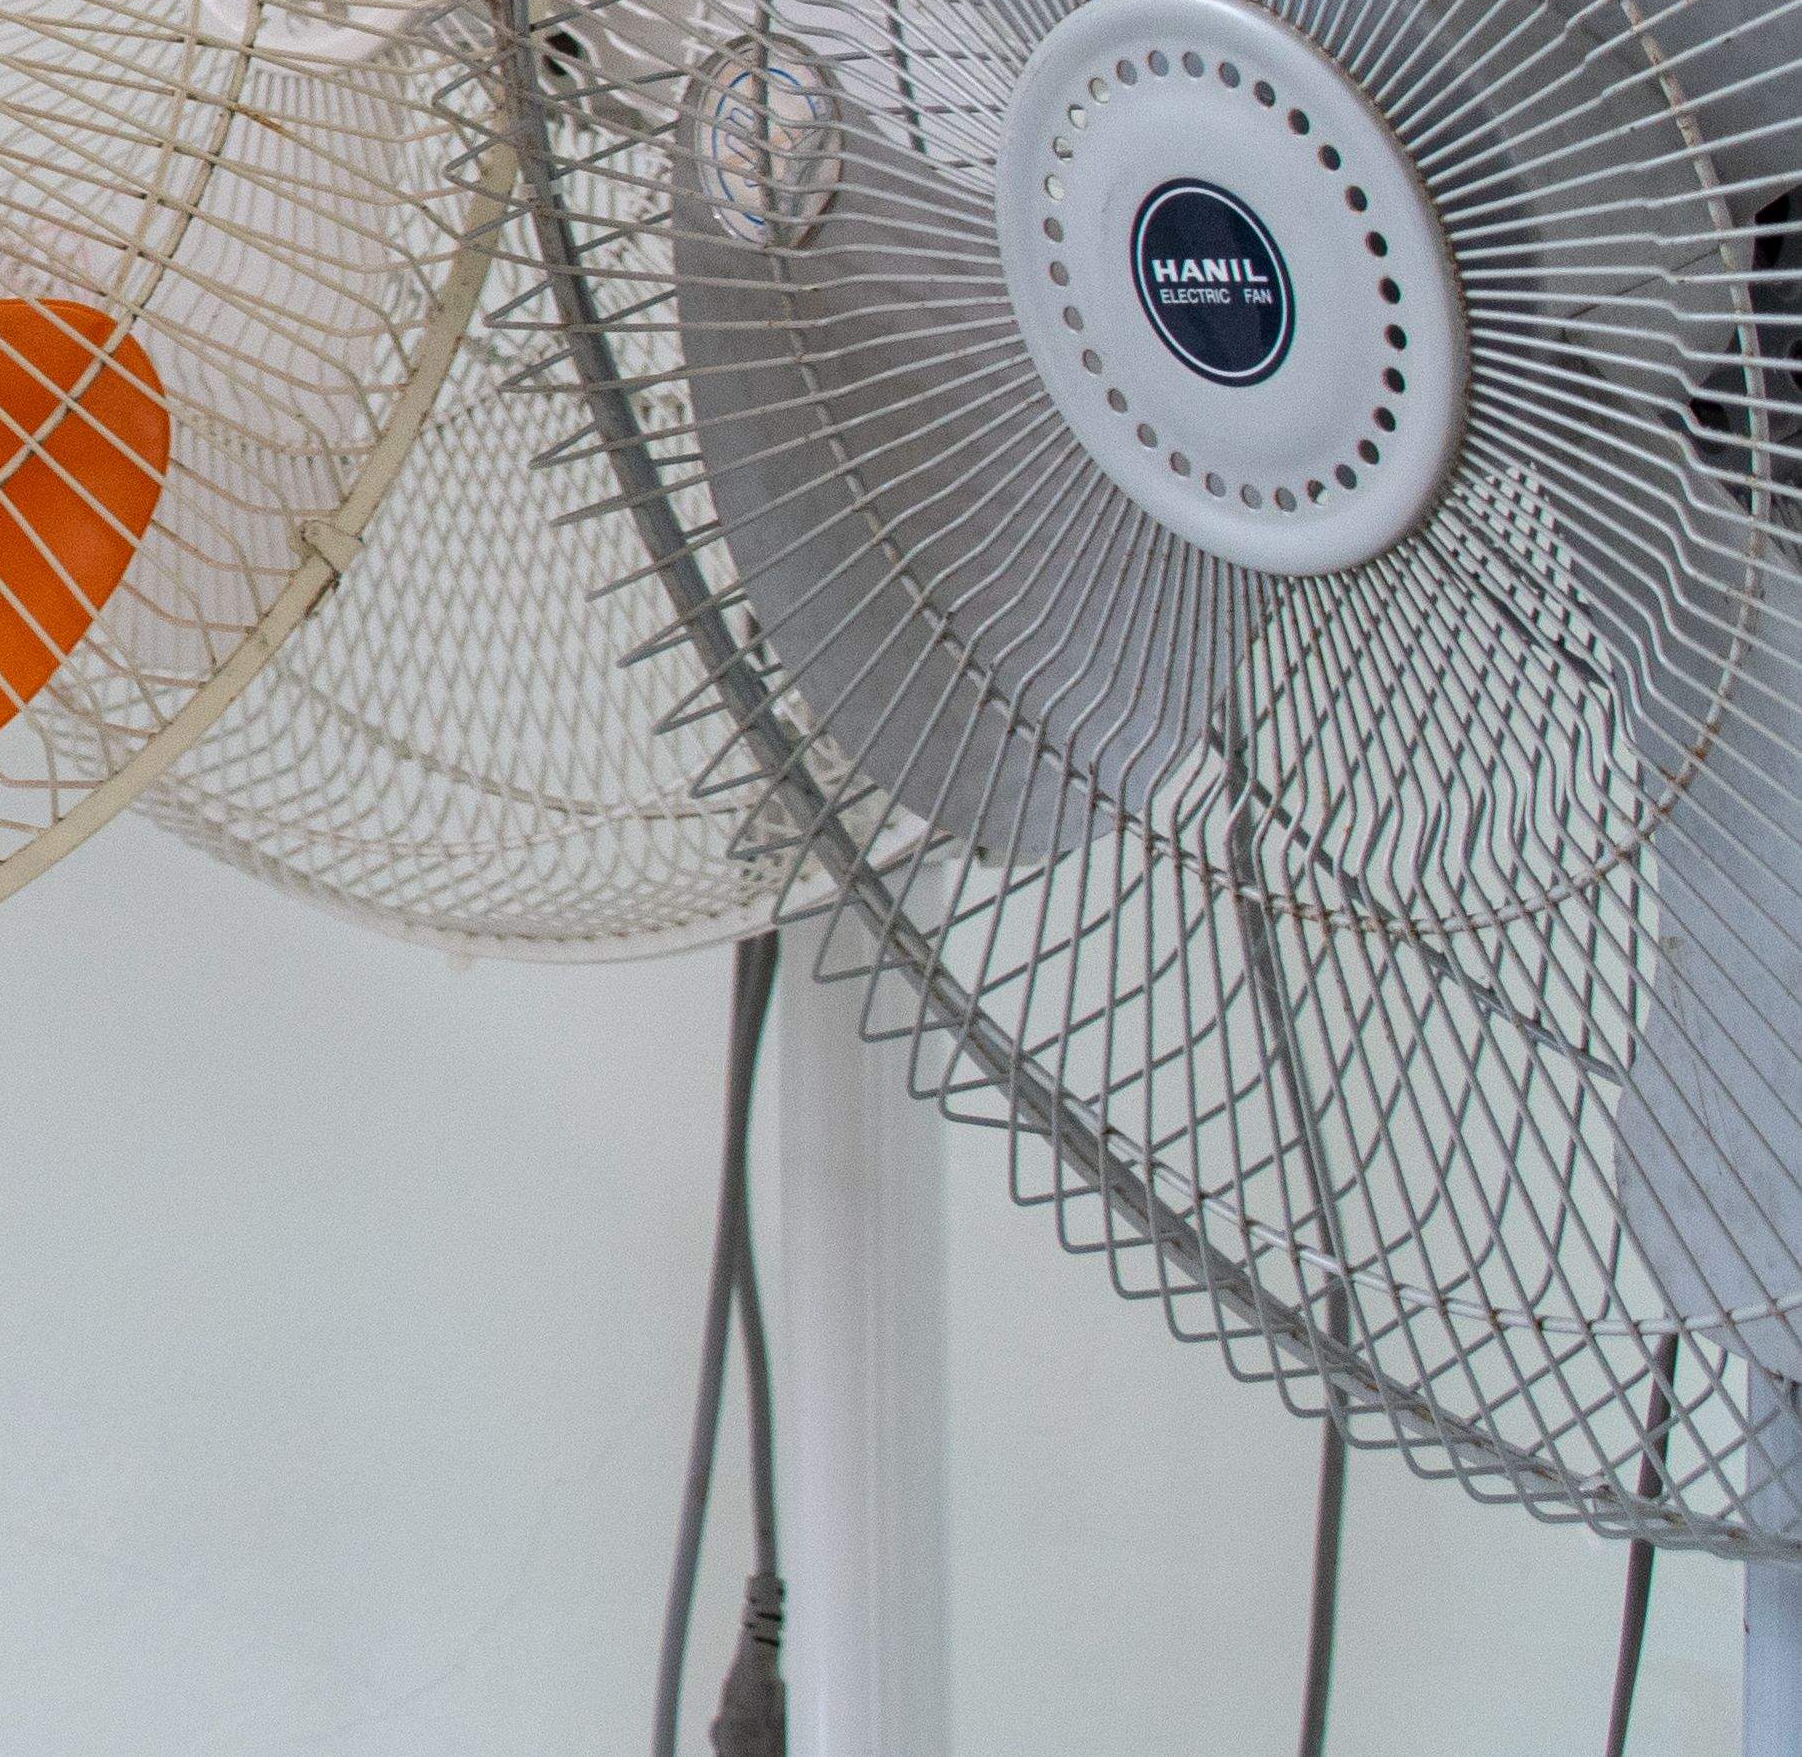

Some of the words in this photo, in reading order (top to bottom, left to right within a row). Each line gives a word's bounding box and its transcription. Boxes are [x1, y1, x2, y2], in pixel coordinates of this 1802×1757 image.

[1151, 258, 1268, 283] HANIL
[1159, 288, 1231, 304] ELECTRIC
[1244, 288, 1272, 305] FAN
